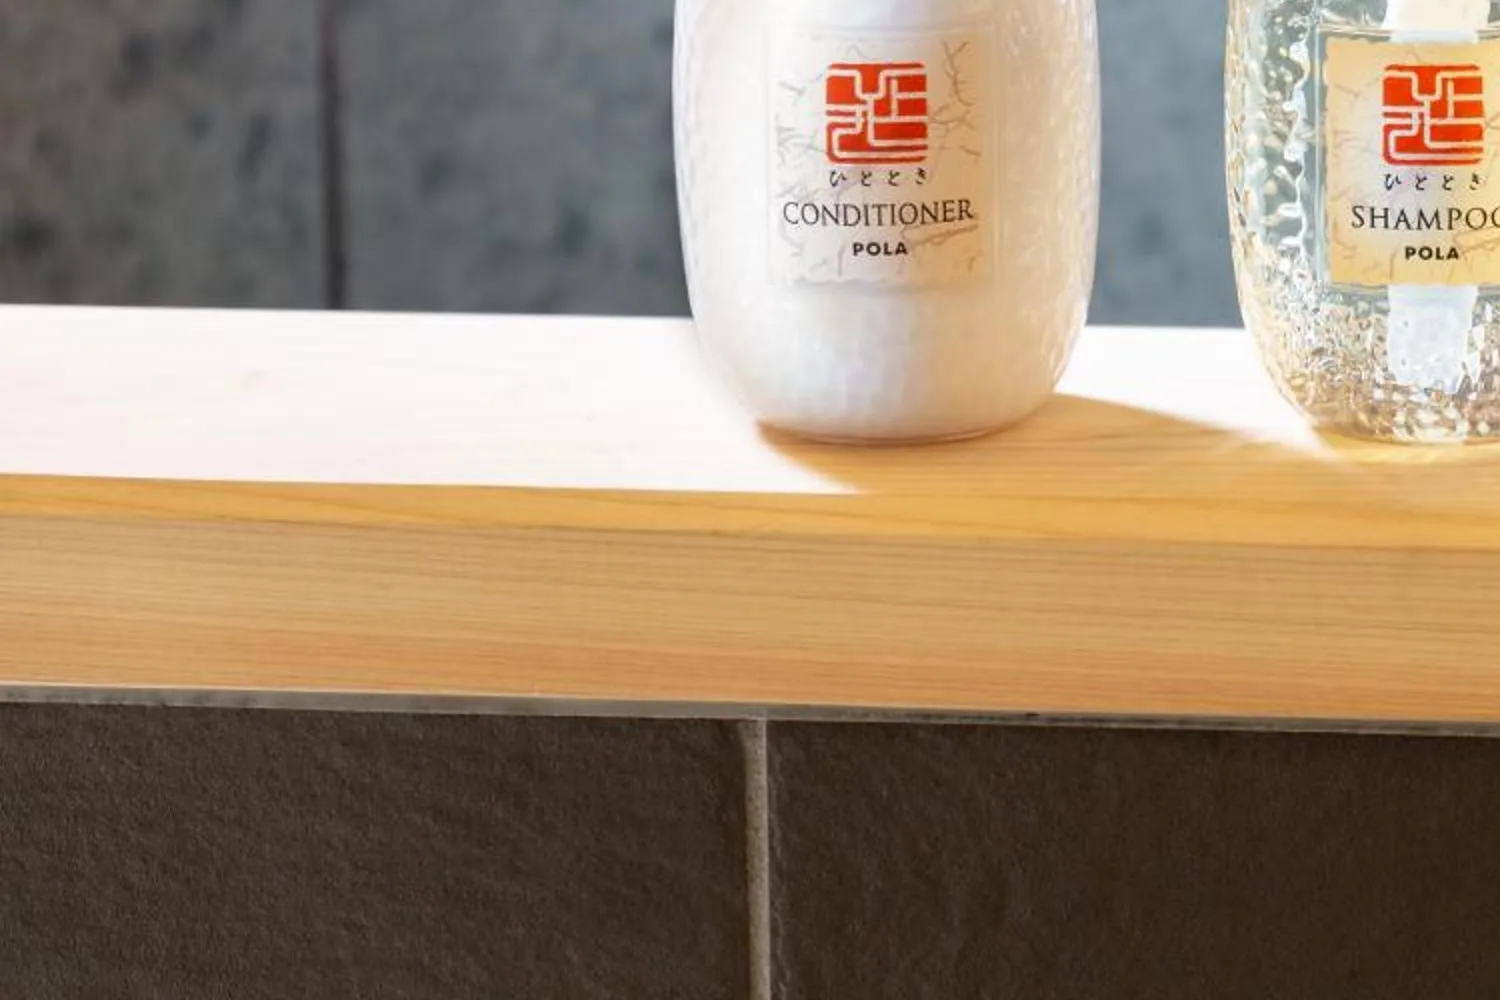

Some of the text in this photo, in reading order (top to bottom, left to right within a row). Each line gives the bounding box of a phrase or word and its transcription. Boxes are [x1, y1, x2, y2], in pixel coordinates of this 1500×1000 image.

[829, 167, 927, 187] ひととき
[1384, 173, 1482, 191] ひととき
[783, 199, 974, 227] CONDITIONER
[852, 241, 908, 257] POLA
[1405, 246, 1460, 261] POLA
